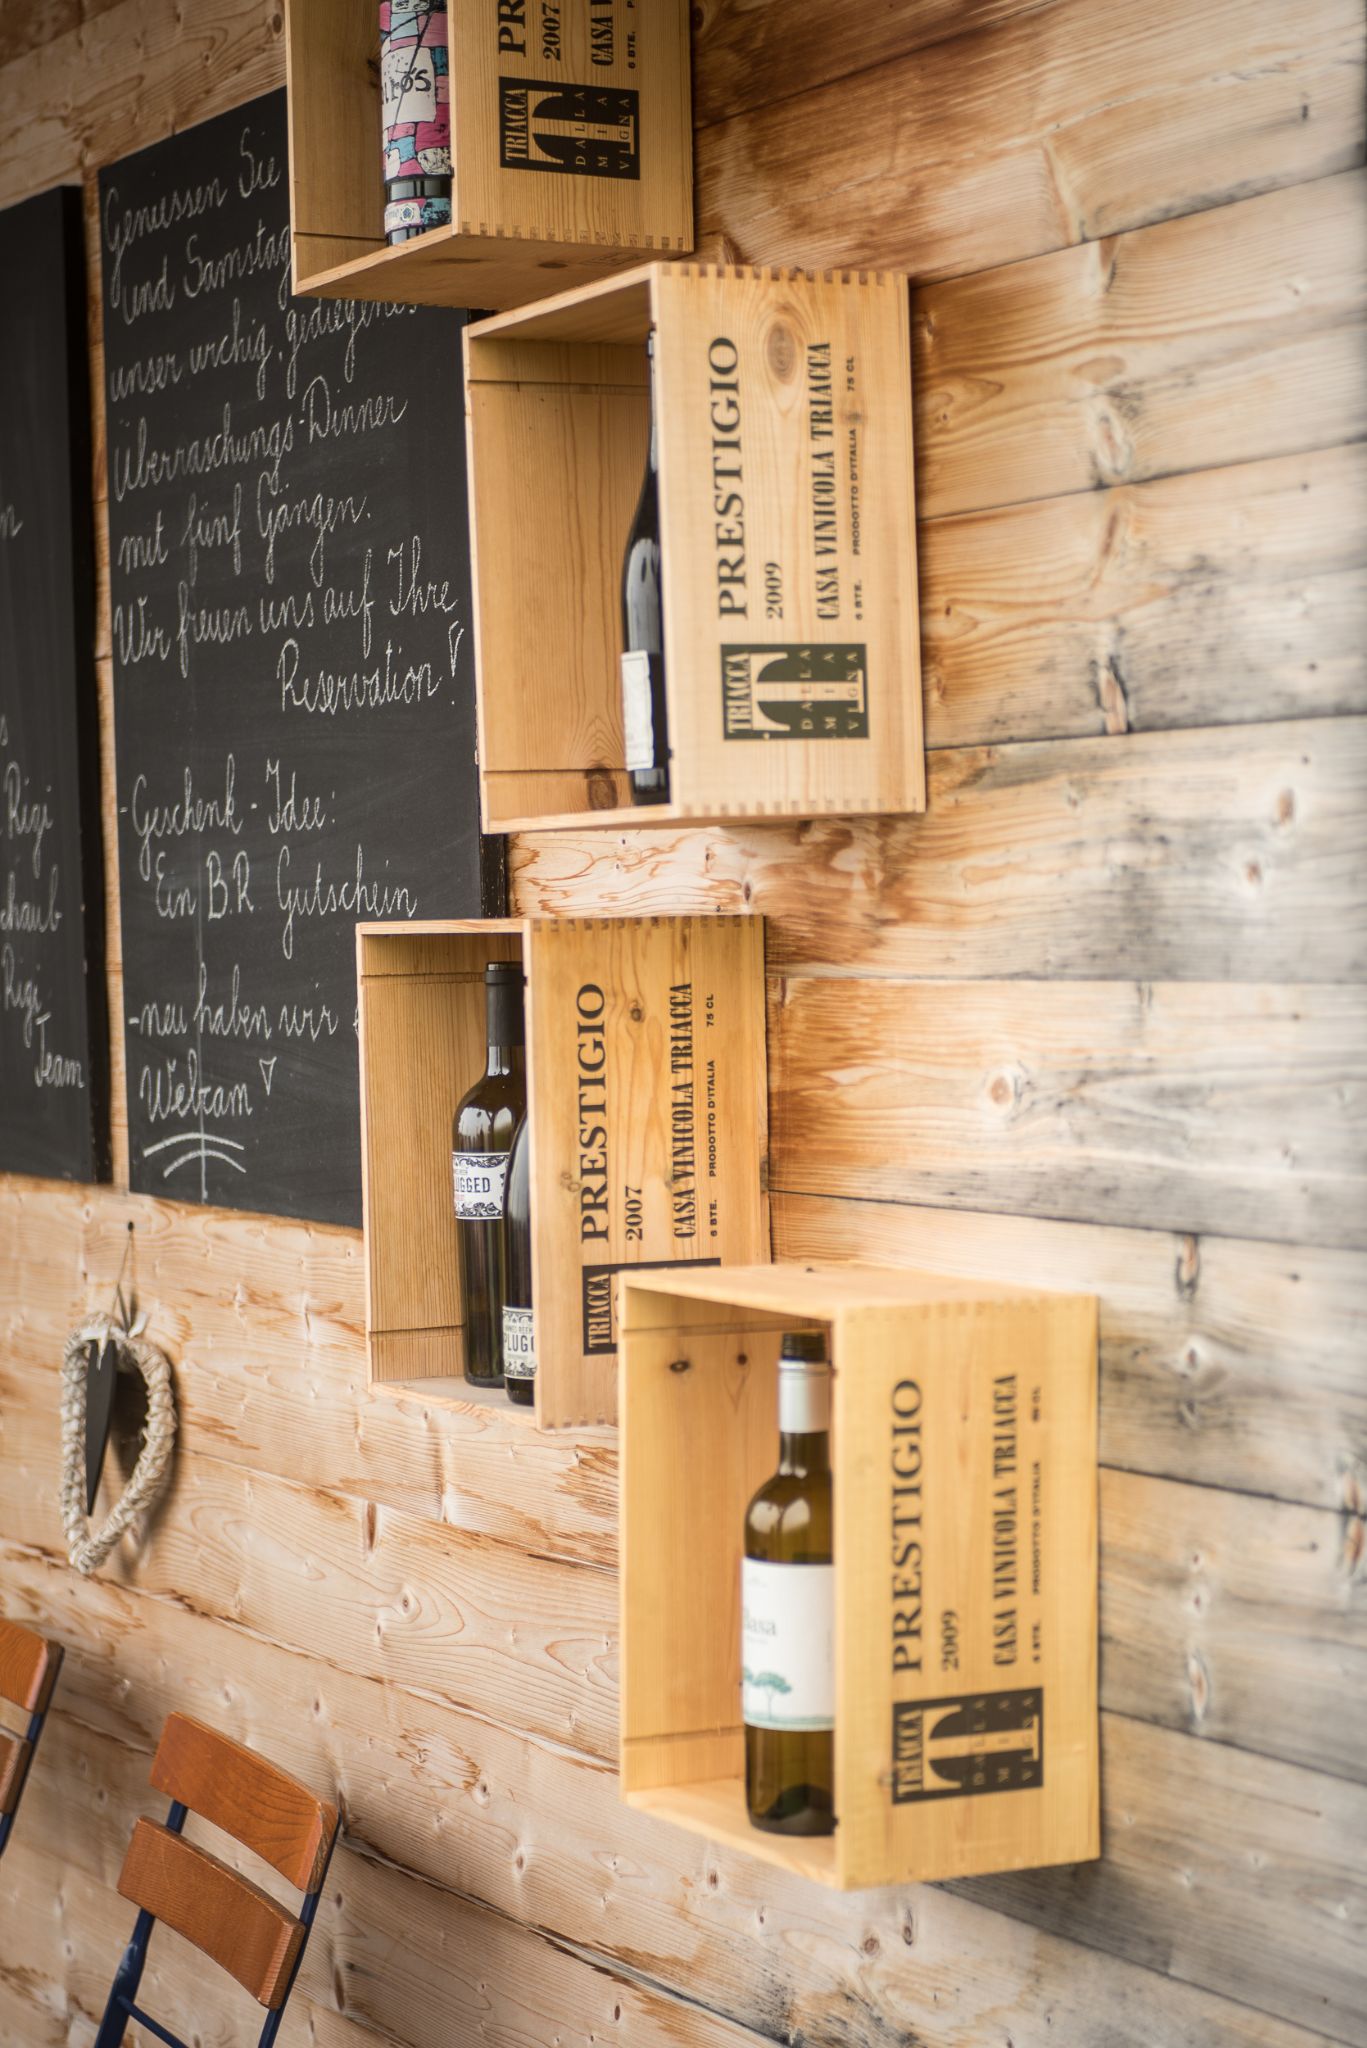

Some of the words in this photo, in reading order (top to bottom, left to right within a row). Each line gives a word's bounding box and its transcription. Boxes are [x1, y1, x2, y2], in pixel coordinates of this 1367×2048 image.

[542, 2, 561, 62] 2007
[591, 16, 613, 66] CASA
[505, 88, 530, 161] TRIACCA
[574, 91, 587, 167] DALLA
[597, 95, 609, 168] MIA
[618, 98, 631, 170] VIGNA
[104, 186, 228, 309] Geniessen
[238, 127, 281, 198] Sie
[110, 351, 182, 402] unser
[807, 343, 834, 441] TRIACCA
[845, 356, 854, 372] CL
[708, 336, 749, 620] PRESTIGIO
[848, 428, 859, 481] D'ITALIA
[117, 508, 168, 575] mit
[180, 482, 243, 588] fünf
[811, 450, 838, 557] VINICOLA
[850, 486, 861, 556] PRODOTTO
[113, 595, 171, 666] Wir
[176, 580, 253, 679] freuen
[260, 592, 315, 634] uns
[323, 548, 375, 660] auf
[386, 534, 459, 616] Ihre
[765, 562, 784, 620] 2009
[815, 566, 840, 620] CASA
[725, 652, 752, 733] TRIACCA
[154, 850, 197, 919] Ein
[276, 842, 418, 960] Gutschein
[192, 961, 273, 1041] haben
[277, 982, 339, 1044] wir
[669, 982, 694, 1074] TRIACCA
[705, 993, 714, 1010] CL
[705, 1012, 715, 1028] 75
[34, 1011, 85, 1088] Team
[706, 1059, 716, 1109] D'ITALIA
[576, 983, 610, 1245] PRESTIGIO
[671, 1081, 696, 1183] VINICOLA
[707, 1112, 717, 1178] PRODOTTO
[625, 1185, 644, 1242] 2007
[673, 1188, 697, 1239] CASA
[709, 1199, 718, 1227] BTE.
[709, 1229, 718, 1237] 6
[587, 1273, 612, 1349] TRIACCA
[993, 1373, 1017, 1480] TRIACCA
[892, 1379, 923, 1677] PRESTIGIO
[993, 1487, 1017, 1600] VINICOLA
[940, 1609, 960, 1672] 2009
[993, 1608, 1017, 1667] CASA
